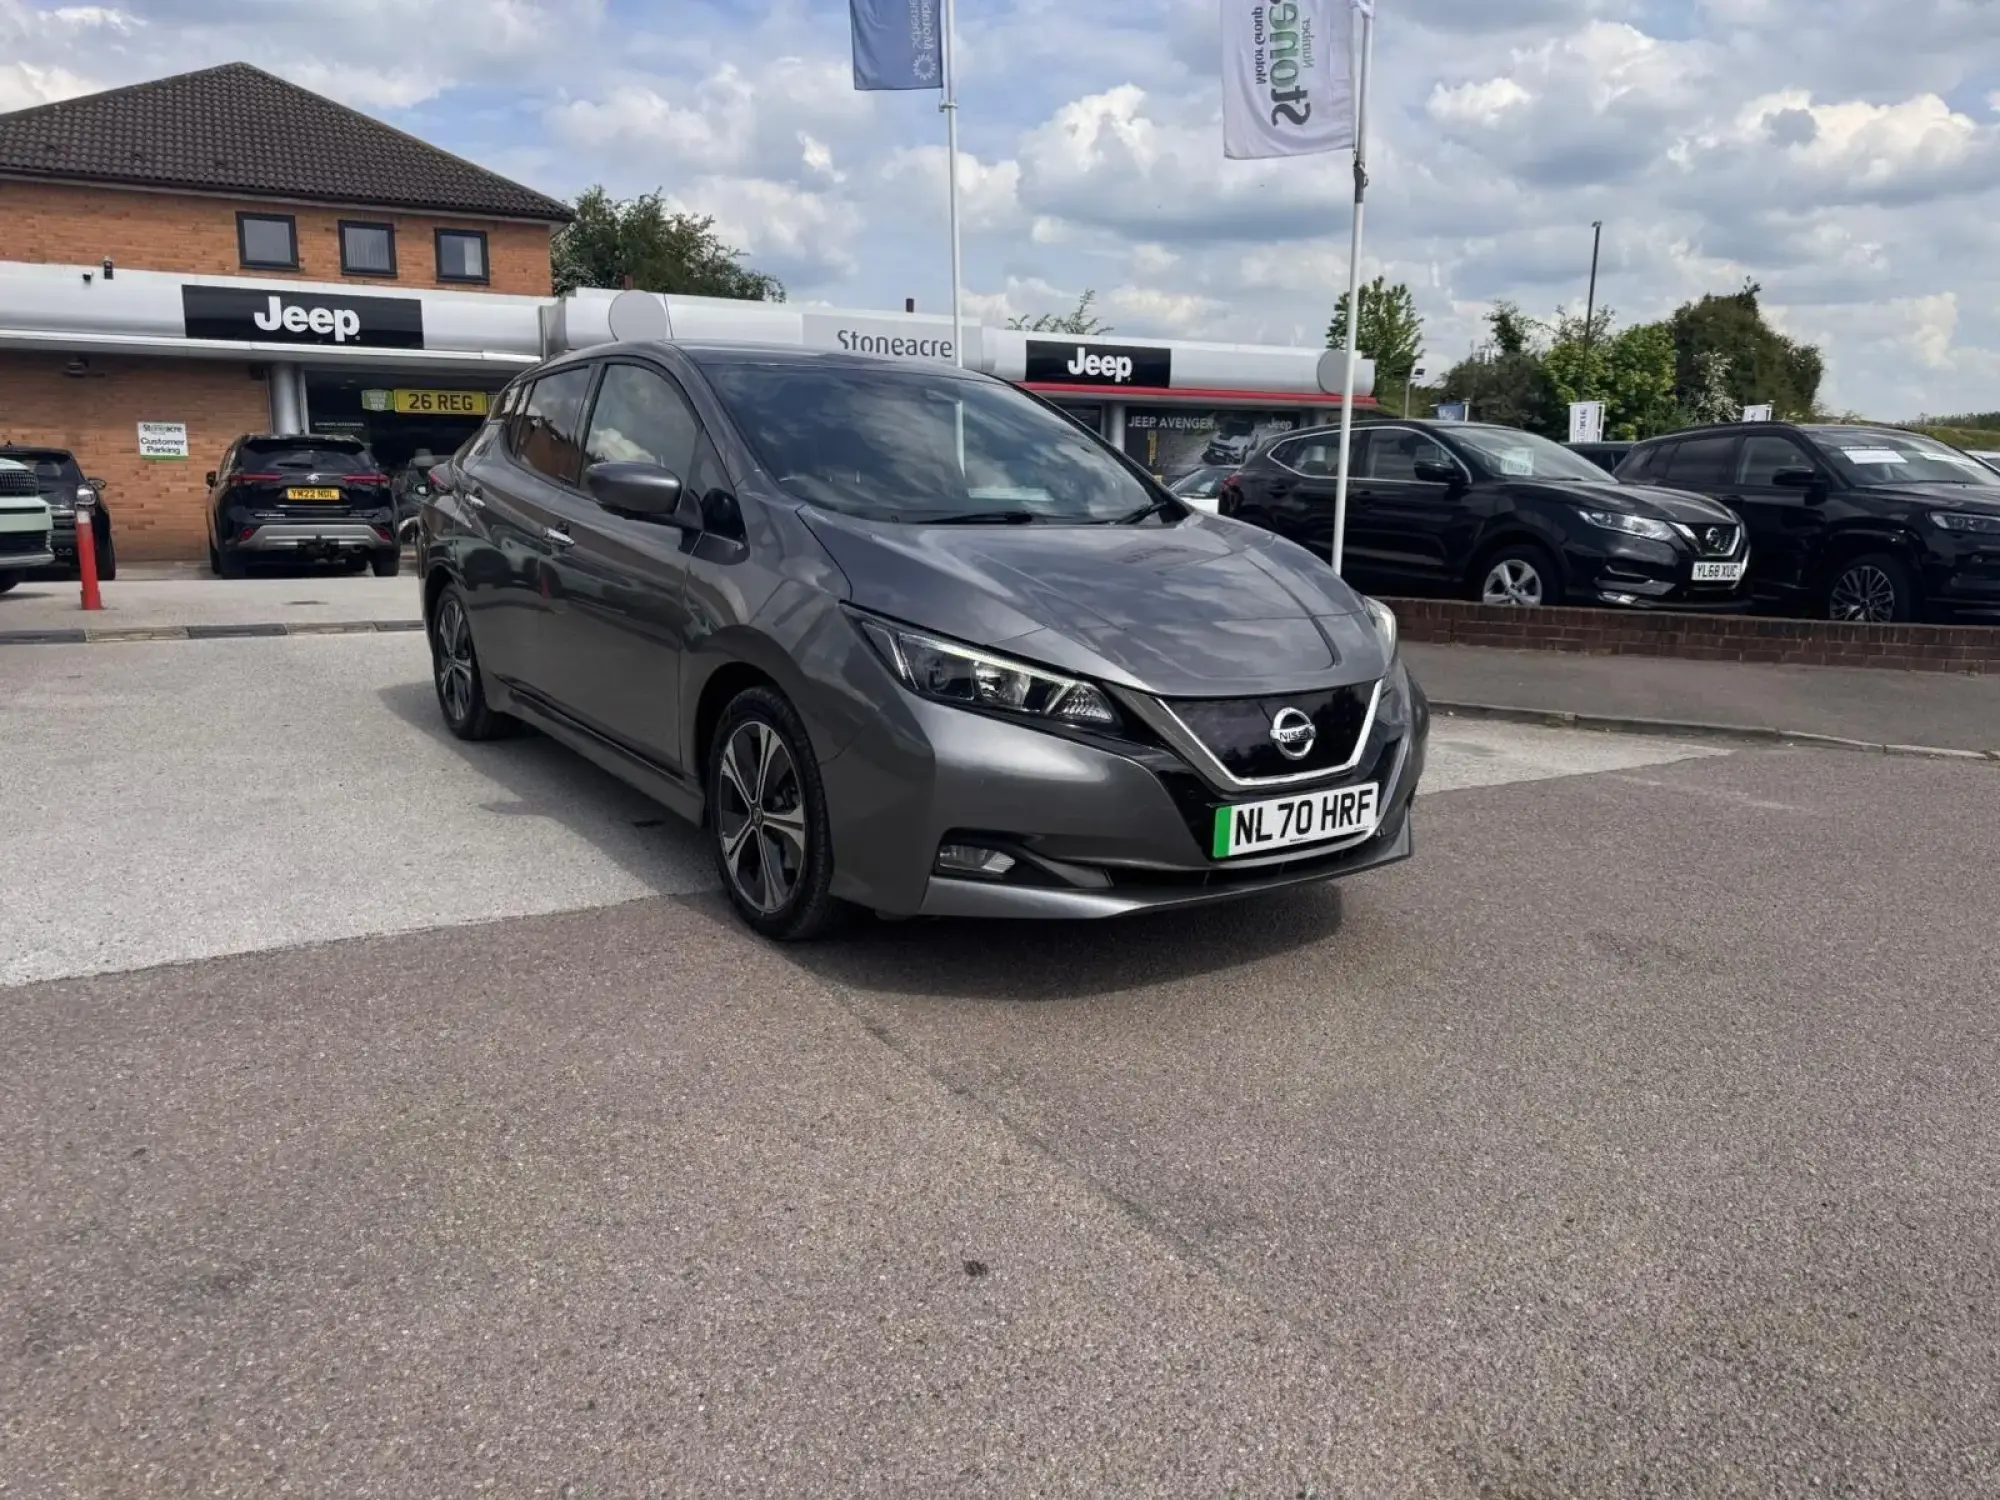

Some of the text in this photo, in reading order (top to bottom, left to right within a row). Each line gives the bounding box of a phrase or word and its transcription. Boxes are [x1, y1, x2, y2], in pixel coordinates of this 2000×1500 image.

[253, 295, 360, 342] Jeep
[837, 329, 953, 358] Stoneacre
[1067, 346, 1133, 383] Jeep
[408, 393, 473, 411] 26 REG
[1128, 415, 1215, 430] JEEP AVENGER
[1268, 417, 1293, 431] Jeep
[140, 437, 185, 445] Customer
[146, 446, 180, 455] Parking
[1234, 788, 1374, 846] NL70 HRF
